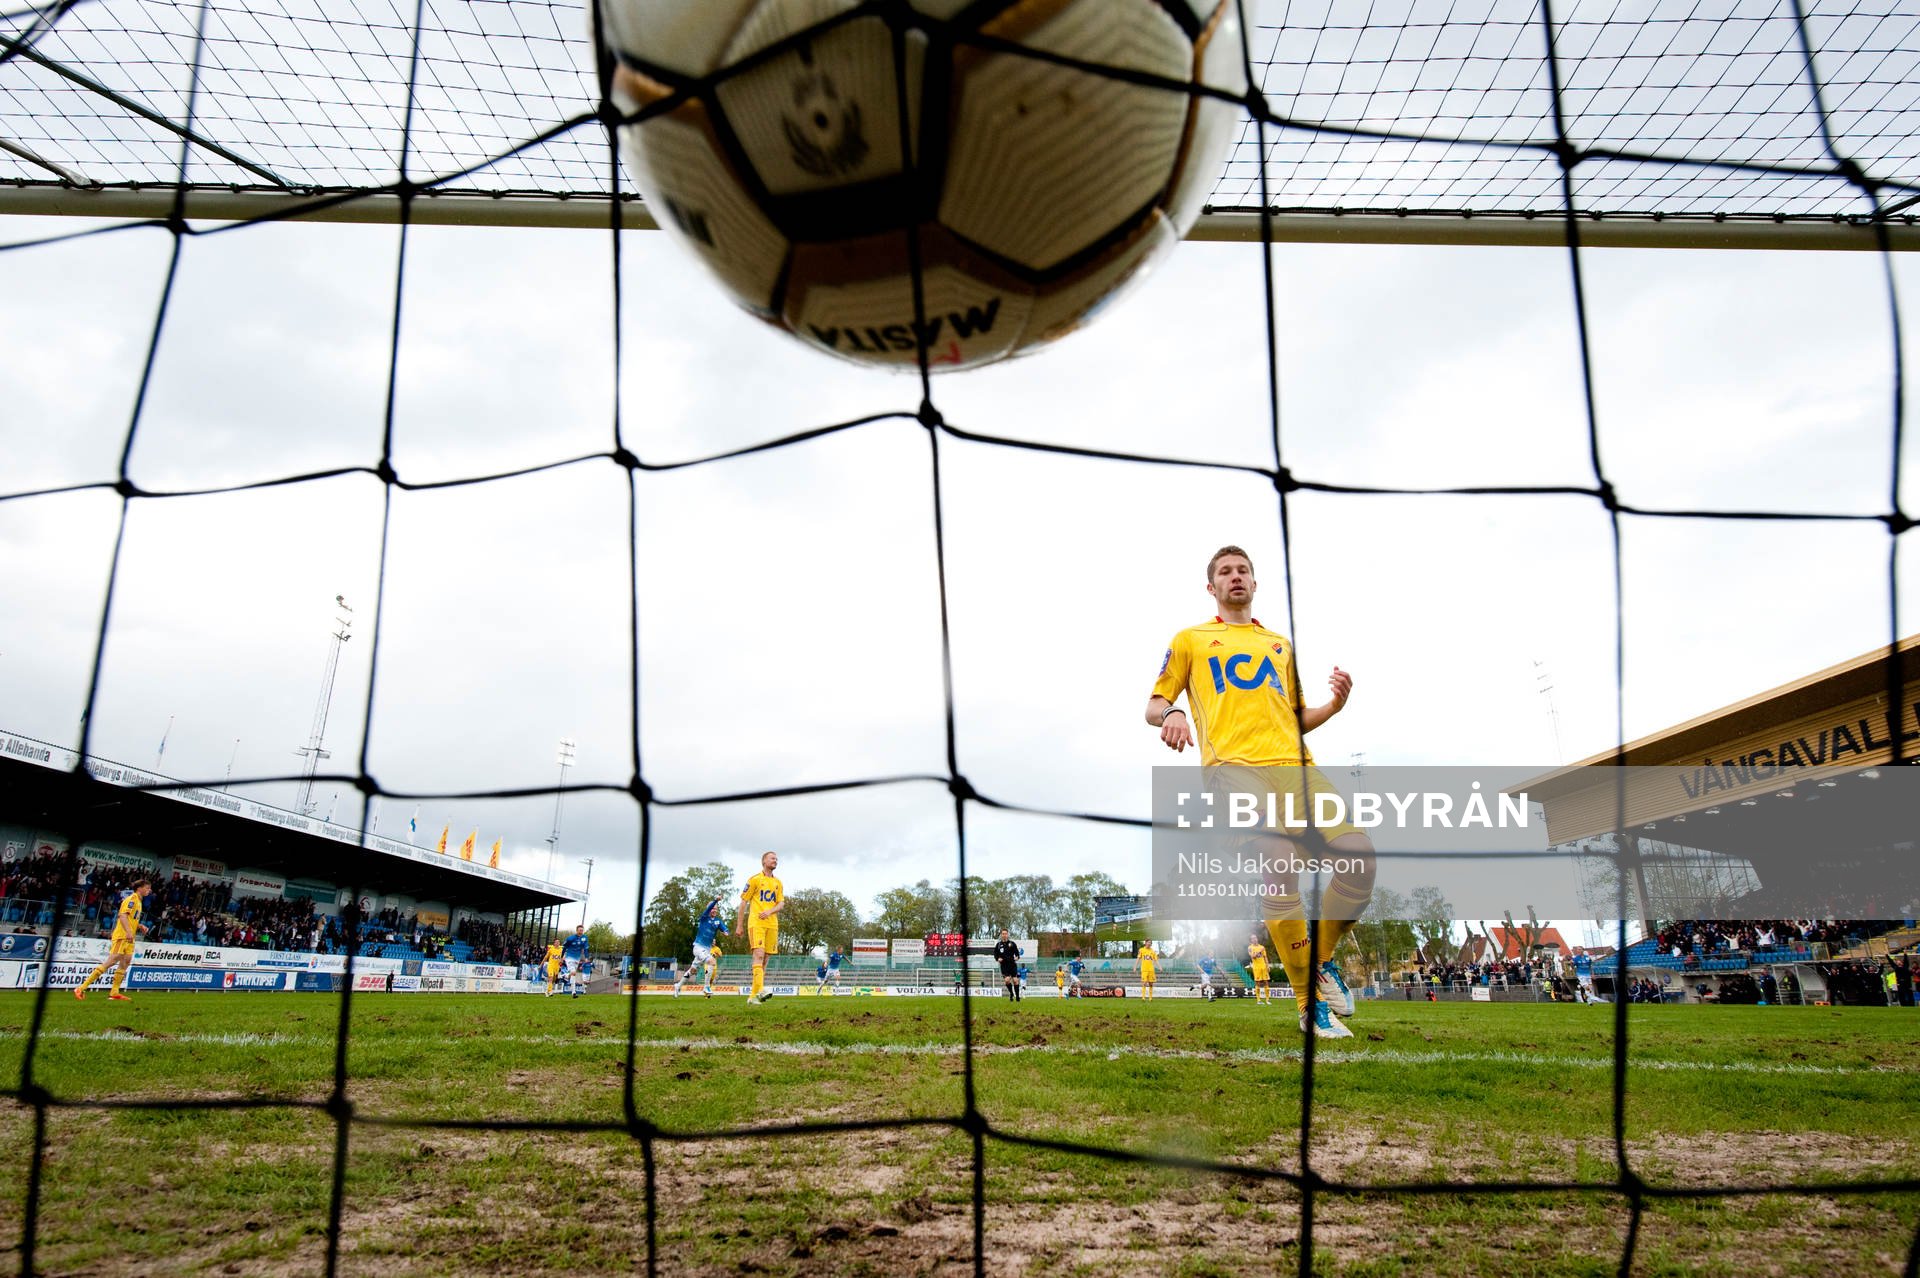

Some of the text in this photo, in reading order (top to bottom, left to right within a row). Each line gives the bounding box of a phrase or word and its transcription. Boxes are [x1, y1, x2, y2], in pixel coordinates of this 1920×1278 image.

[1208, 653, 1286, 697] ICA
[5, 737, 50, 762] Allehanda
[84, 760, 122, 781] elleborgs
[213, 793, 241, 812] Allehanda
[760, 890, 777, 903] ICA
[143, 949, 202, 964] Heisterkamp
[205, 951, 221, 960] BCA
[359, 976, 386, 989] DHL
